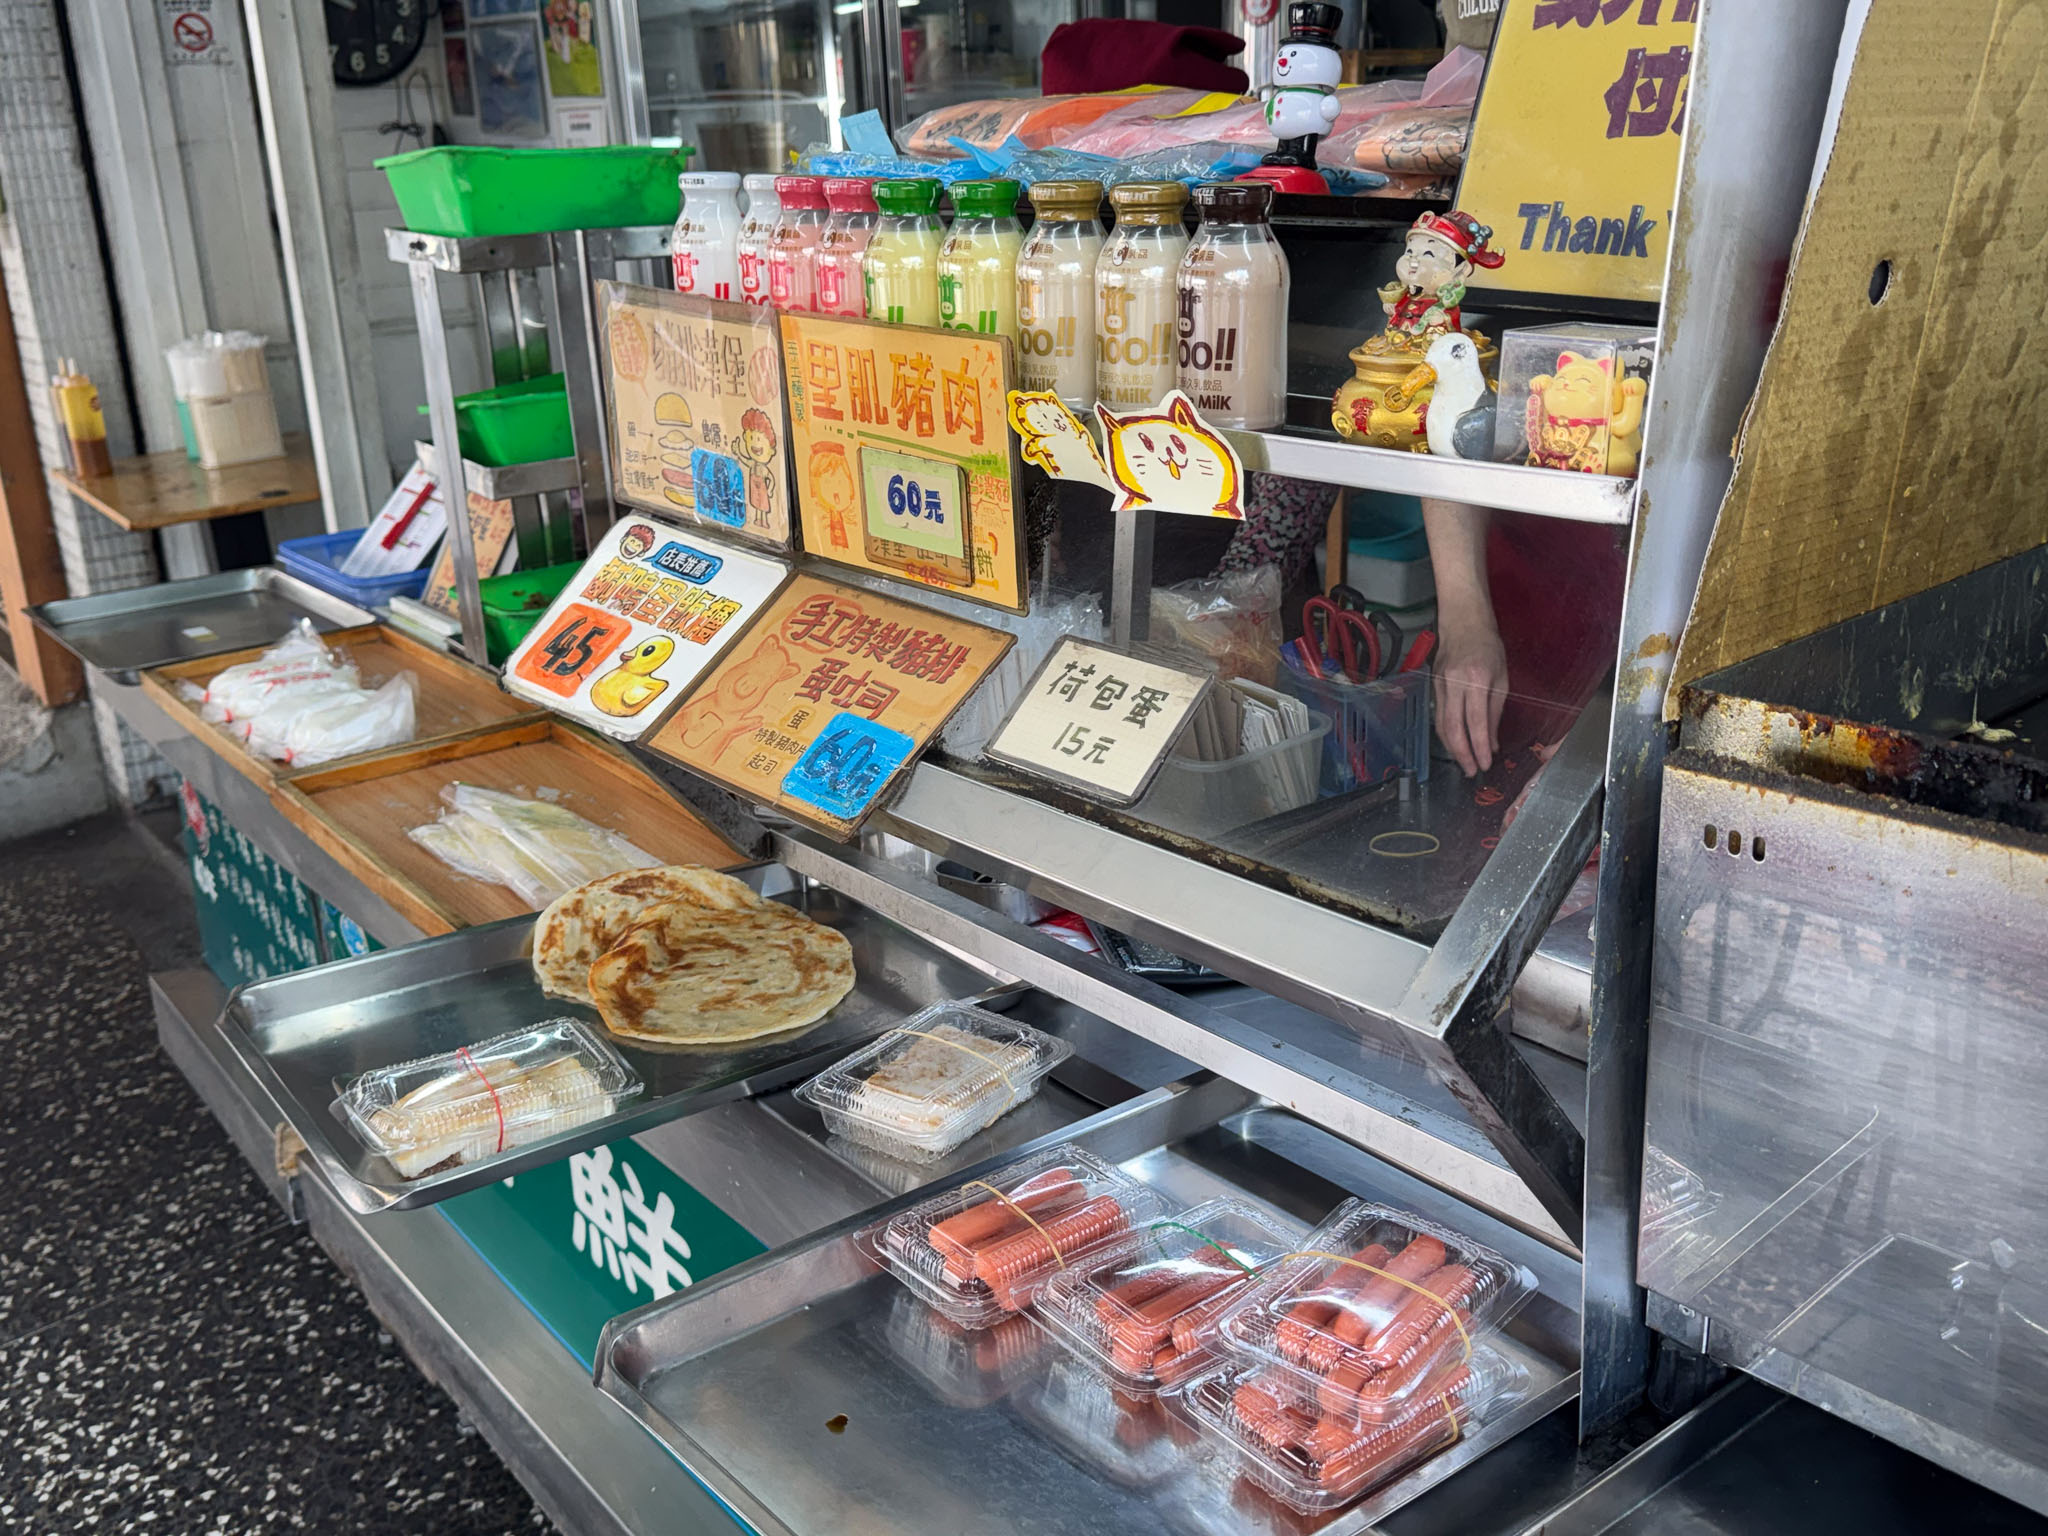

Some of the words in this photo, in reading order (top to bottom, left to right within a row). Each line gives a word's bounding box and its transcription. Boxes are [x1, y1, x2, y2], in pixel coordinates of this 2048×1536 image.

[376, 43, 390, 64] 5
[391, 24, 404, 43] 4
[350, 51, 366, 72] 6
[1517, 201, 1657, 258] Thank
[1018, 316, 1077, 357] oo!!
[1177, 328, 1237, 371] oo!!
[807, 339, 985, 446] 里肌豬肉
[887, 474, 945, 524] 60元
[541, 616, 610, 677] 45
[791, 600, 972, 684] 手工特製豬排
[795, 657, 900, 720] 蛋吐司
[1046, 660, 1169, 729] 荷包蛋
[787, 709, 810, 730] 蛋
[748, 752, 778, 775] 起司
[753, 727, 809, 760] 特製豬肉片
[1052, 721, 1117, 764] 15元
